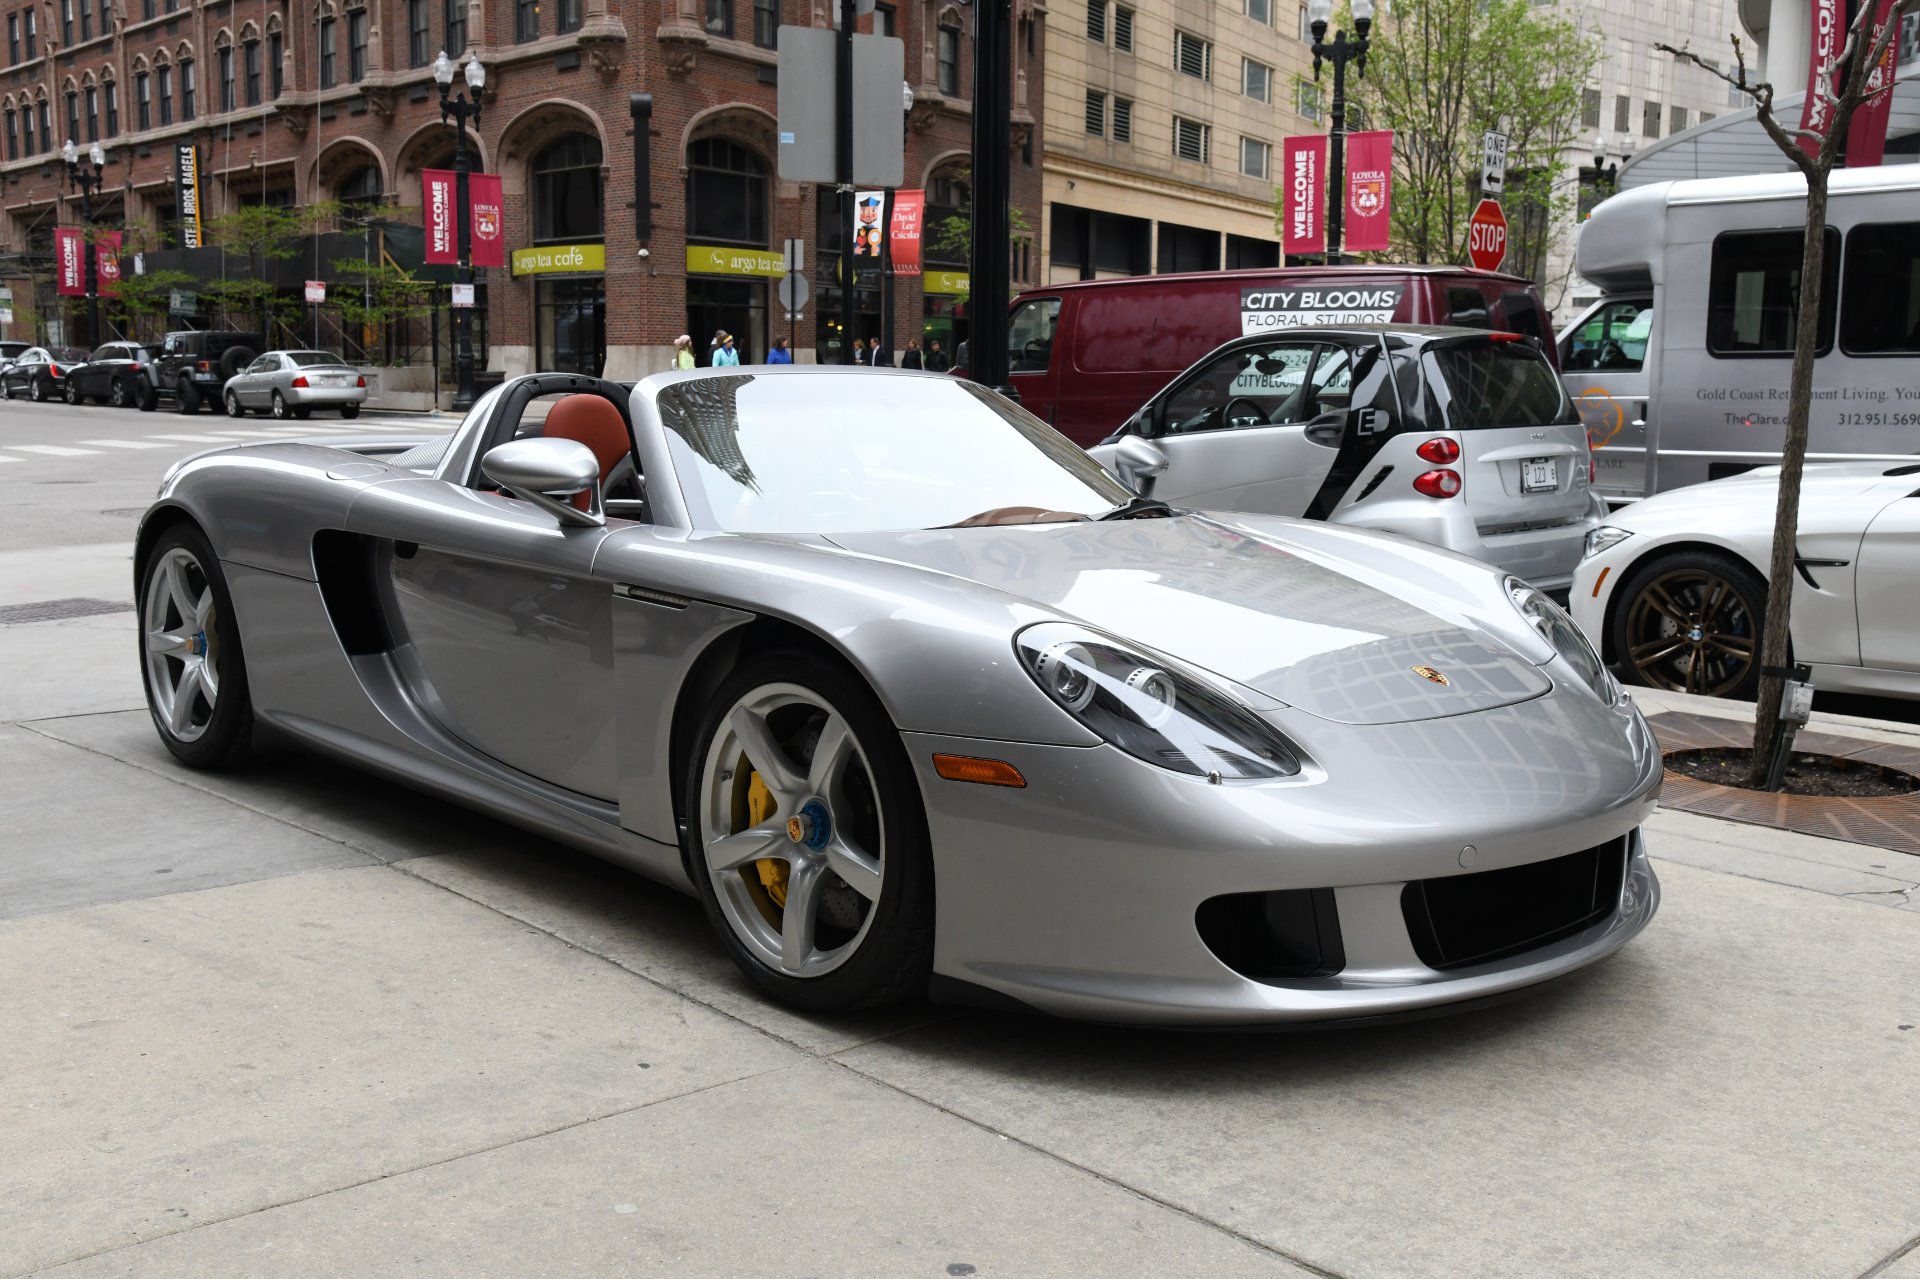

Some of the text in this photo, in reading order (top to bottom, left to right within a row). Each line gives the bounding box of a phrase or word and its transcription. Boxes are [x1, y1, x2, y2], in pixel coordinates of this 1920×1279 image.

[1487, 136, 1504, 153] ONE
[181, 147, 194, 185] BAGELS
[1486, 153, 1503, 168] WAY
[1352, 170, 1385, 180] LOYOLA
[1294, 150, 1307, 239] WELCOME
[432, 181, 444, 252] WELCOME
[894, 212, 916, 222] David
[901, 221, 915, 230] Lee
[1471, 222, 1505, 252] STOP
[63, 237, 74, 287] WELCOME
[521, 247, 583, 272] argo tea café
[731, 256, 756, 273] argo
[758, 257, 771, 270] tea
[1246, 291, 1396, 309] CITY BLOOMS
[1247, 313, 1385, 326] FLORAL STUDIOS
[1696, 388, 1726, 400] Gold
[1729, 388, 1764, 400] Coast
[1843, 387, 1889, 403] Living.
[1534, 467, 1546, 484] 123
